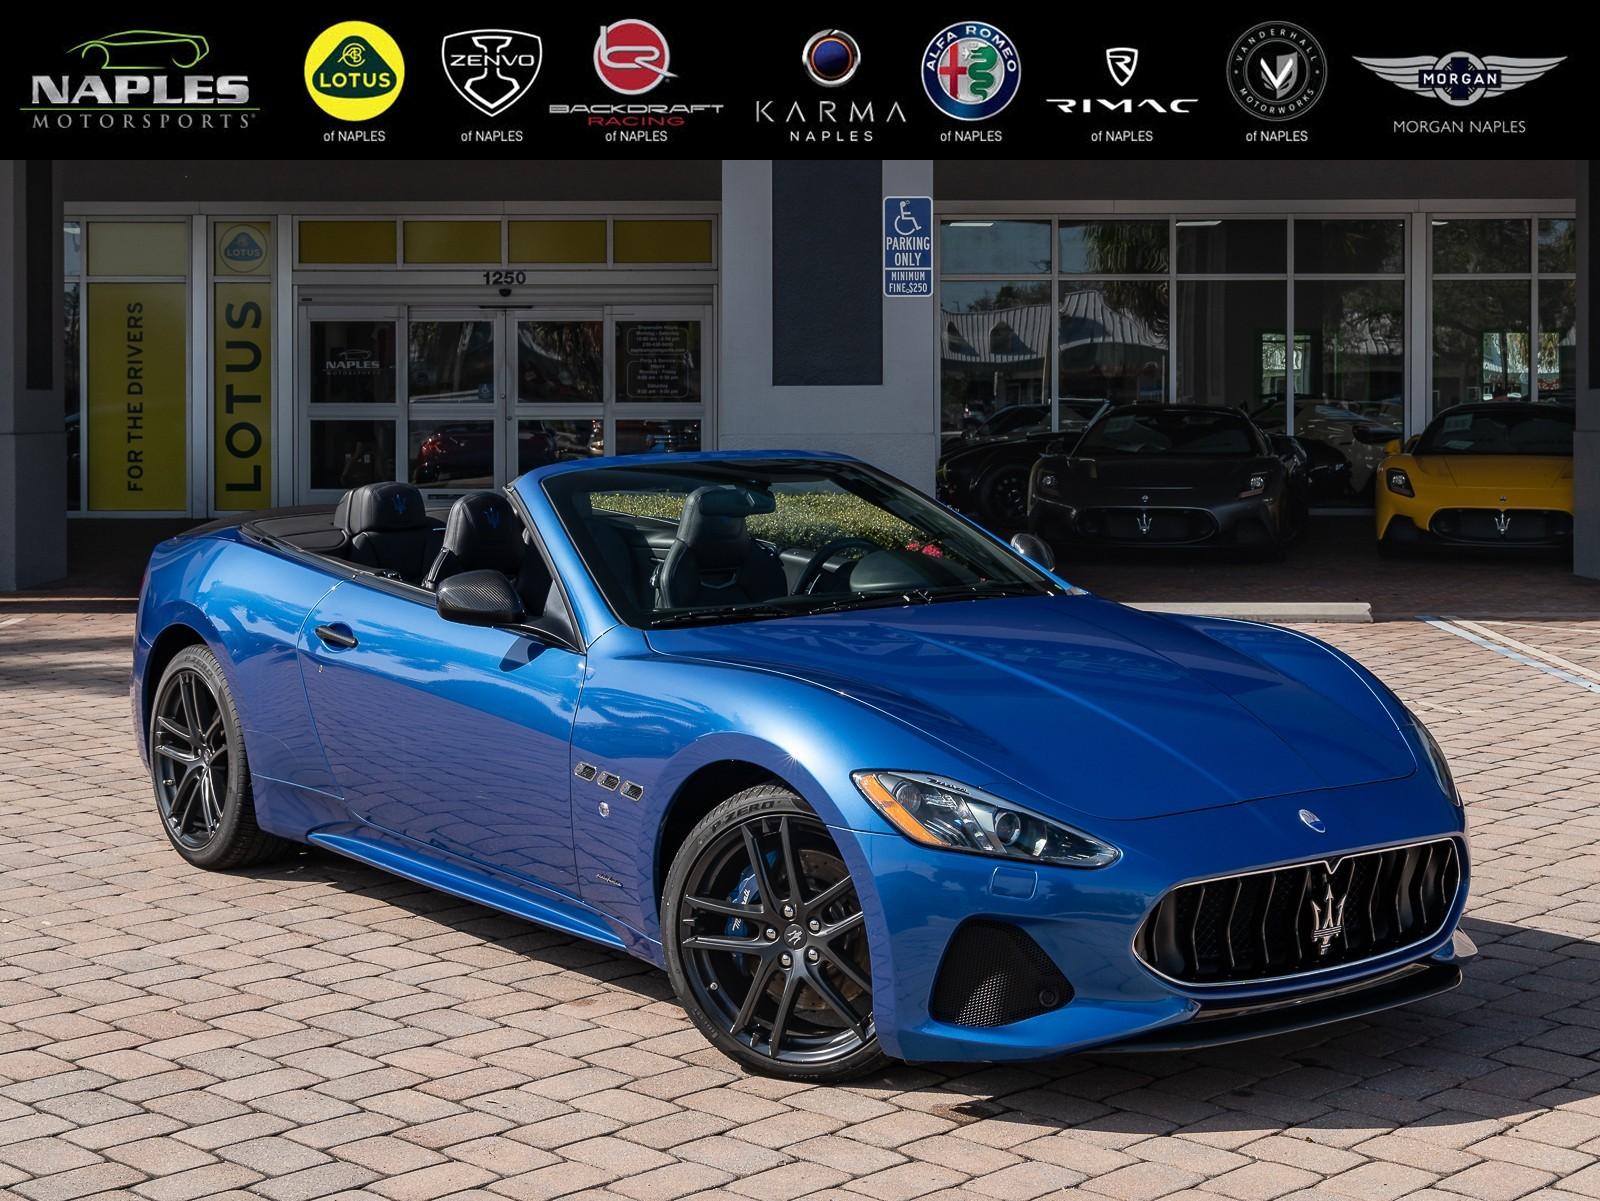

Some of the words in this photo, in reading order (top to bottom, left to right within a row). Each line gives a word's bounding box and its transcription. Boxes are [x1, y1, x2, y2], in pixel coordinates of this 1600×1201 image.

[886, 236, 930, 251] PARKING
[227, 248, 260, 257] LOTUS
[894, 252, 922, 266] ONLY
[483, 271, 527, 285] 1250
[891, 271, 926, 281] MINIMUM
[889, 283, 906, 293] FINE
[909, 282, 928, 294] $250
[127, 302, 144, 395] DRIVERS
[326, 360, 380, 369] NAPLES
[225, 301, 262, 492] LOTUS
[127, 402, 144, 443] THE
[127, 450, 144, 491] FOR
